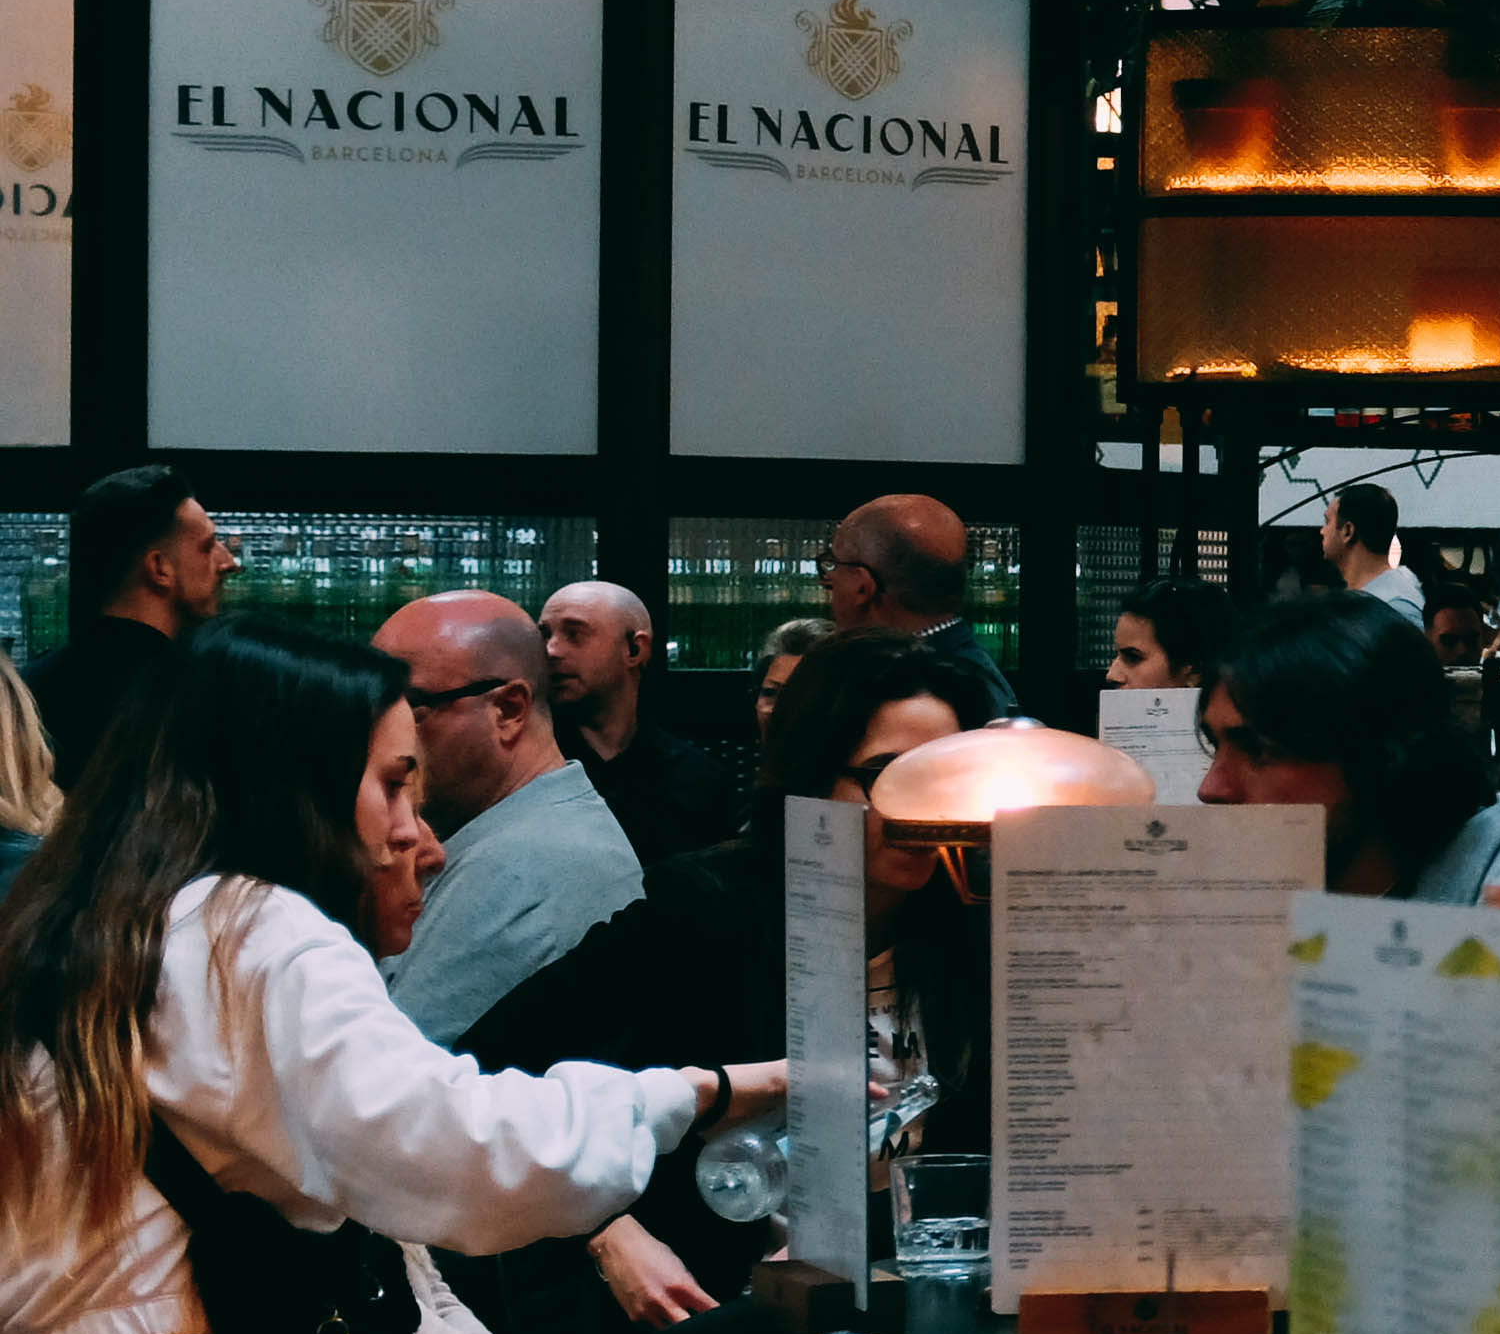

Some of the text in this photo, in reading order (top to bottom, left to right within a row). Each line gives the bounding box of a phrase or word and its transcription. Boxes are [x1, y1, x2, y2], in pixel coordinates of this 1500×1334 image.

[177, 84, 581, 137] EL NACIONAL
[689, 102, 1010, 165] EL NACIONAL
[311, 146, 449, 165] BARCELONA
[795, 165, 906, 187] BARCELONA
